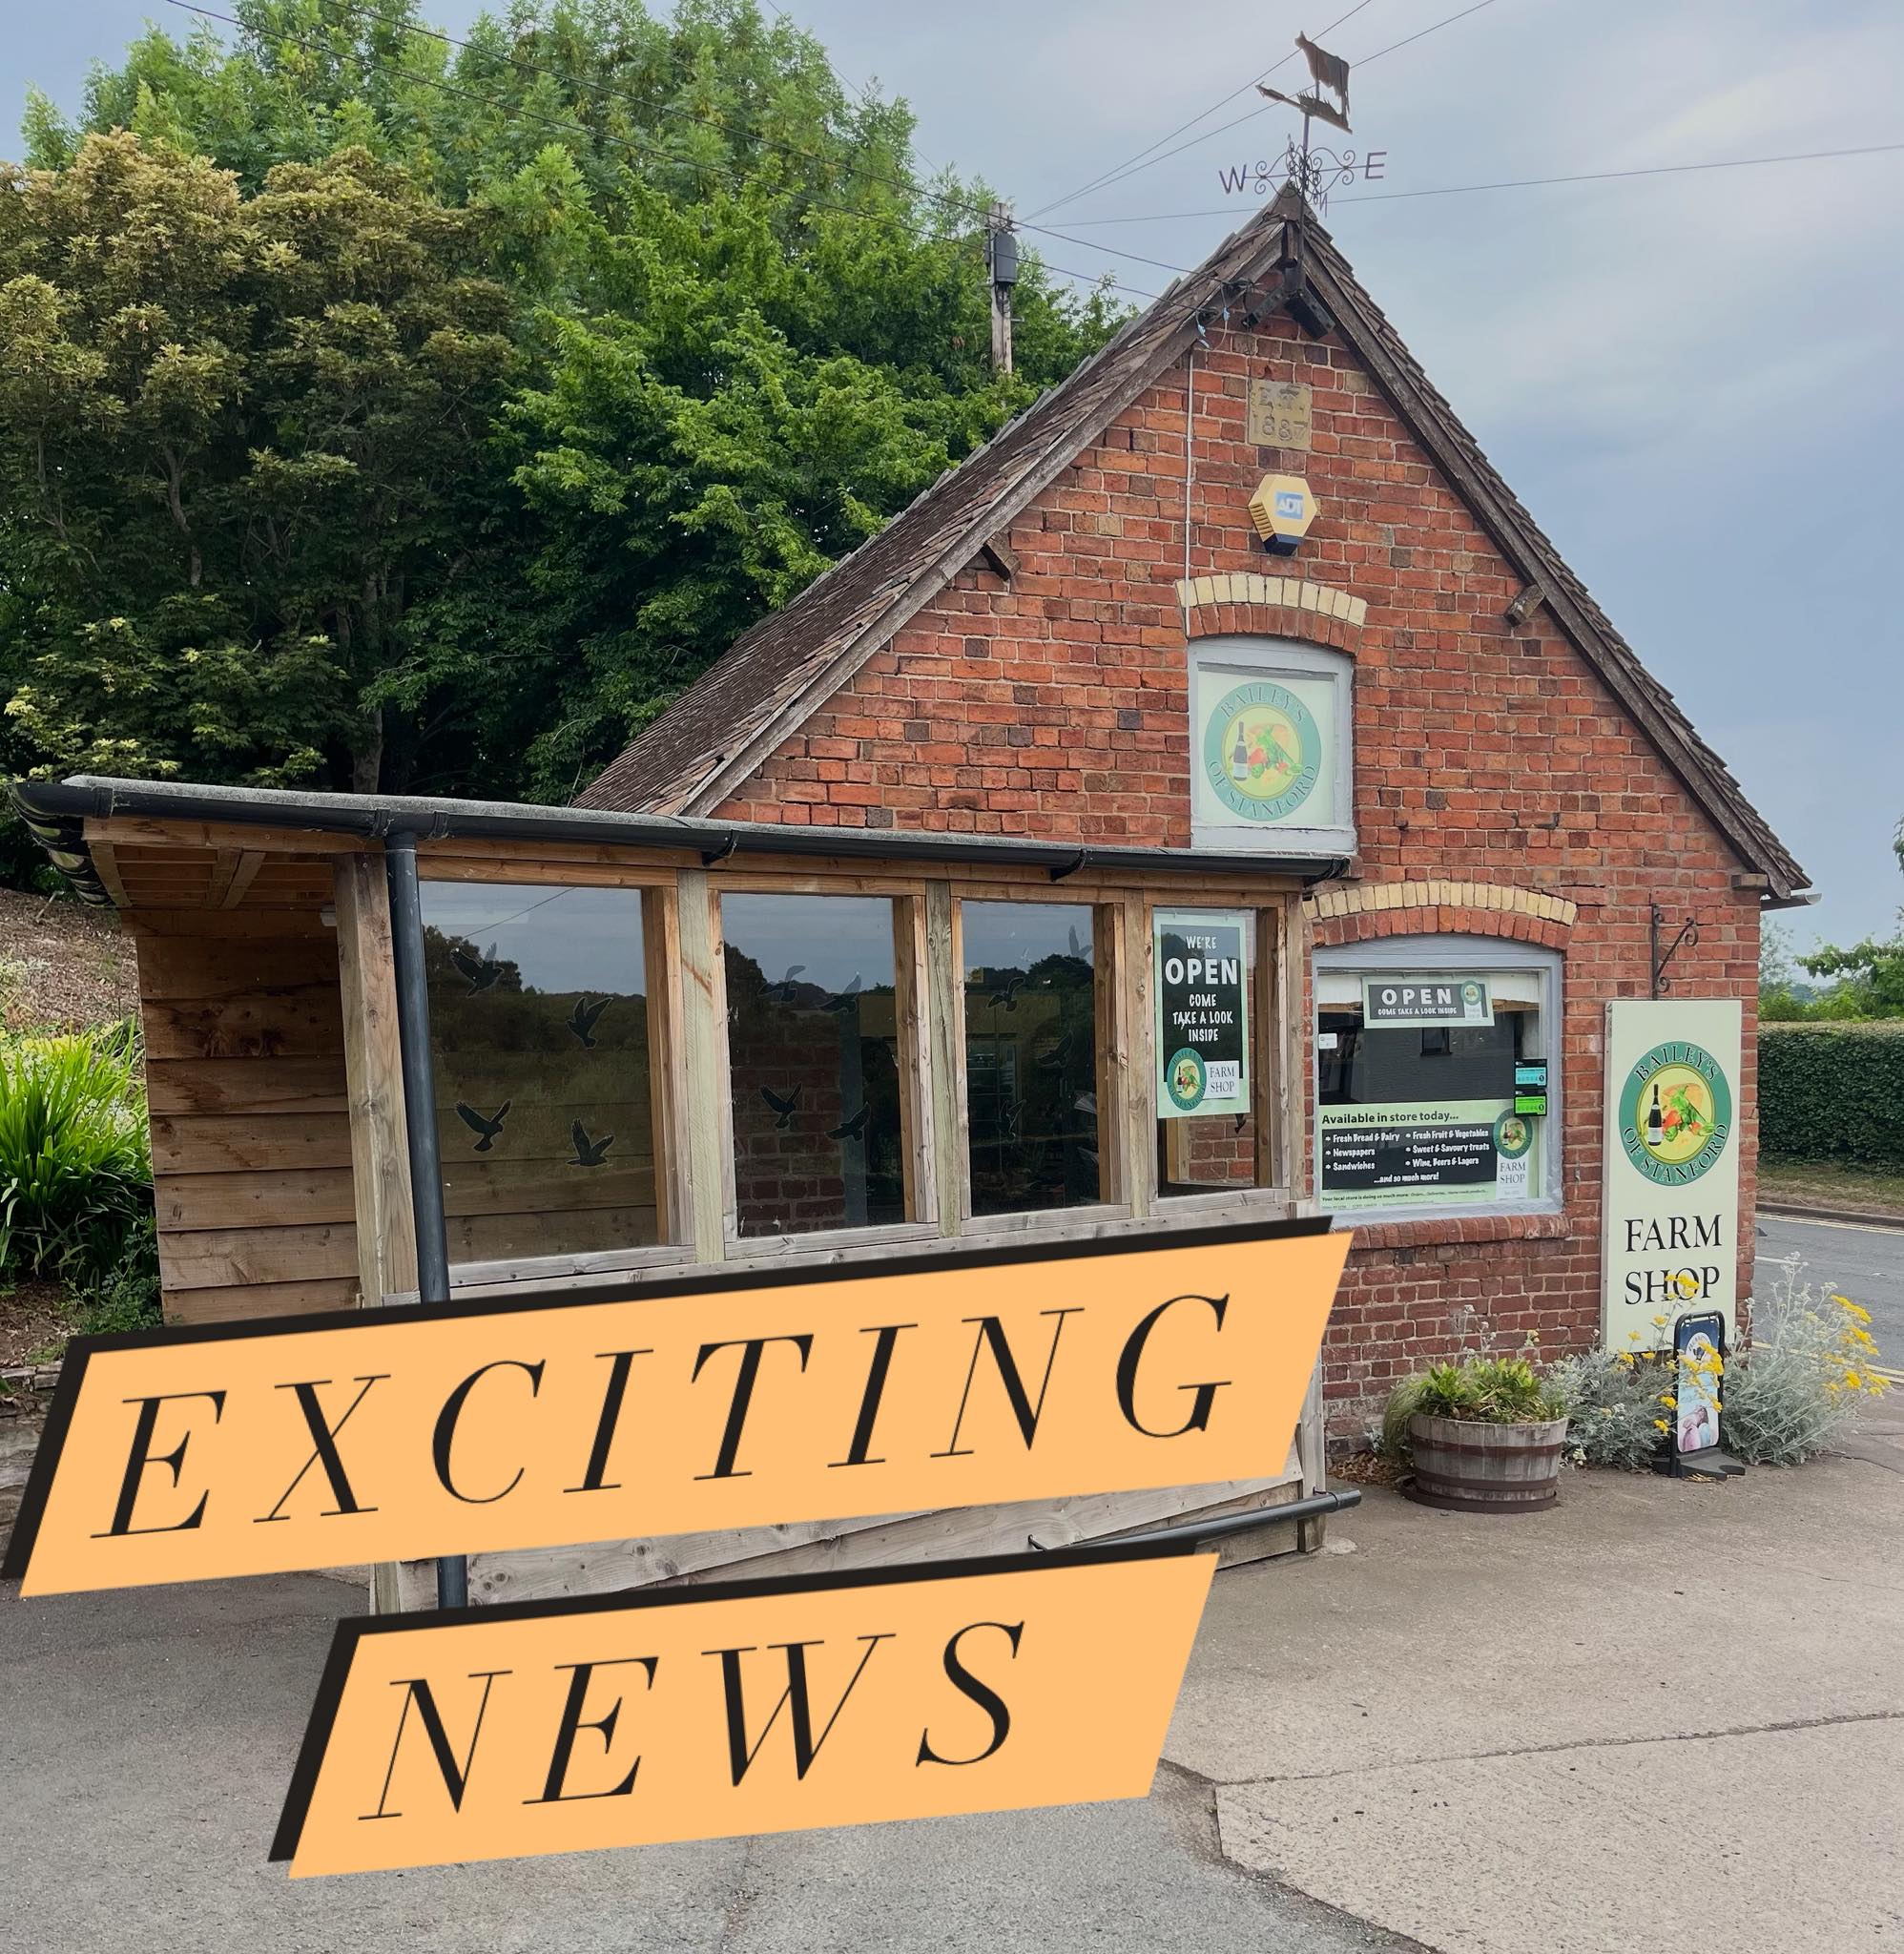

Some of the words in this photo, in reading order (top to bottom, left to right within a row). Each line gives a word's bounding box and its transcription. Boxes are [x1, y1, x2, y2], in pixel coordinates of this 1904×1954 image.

[1365, 152, 1387, 179] E
[1219, 164, 1247, 194] W
[1276, 497, 1303, 515] ADT
[1220, 685, 1306, 723] BAILEY'S
[1209, 759, 1230, 788] OF
[1228, 764, 1316, 819] STANFORD
[1186, 935, 1217, 949] WE'RE
[1165, 957, 1238, 986] OPEN
[1189, 993, 1217, 1008] COME
[1381, 988, 1452, 1006] OPEN
[1172, 1011, 1197, 1028] TAKE
[1199, 1011, 1207, 1025] A
[1210, 1010, 1233, 1025] LOOK
[1188, 1029, 1219, 1042] INSIDE
[1635, 1045, 1721, 1082] BAILEY'S
[1210, 1067, 1235, 1078] FARM
[1210, 1080, 1235, 1093] SHOP
[1322, 1112, 1375, 1124] Available
[1377, 1112, 1388, 1122] in
[1390, 1112, 1418, 1122] store
[1419, 1111, 1459, 1122] today...
[1333, 1133, 1353, 1143] Fresh
[1353, 1133, 1374, 1142] Bread
[1375, 1133, 1380, 1141] &
[1380, 1132, 1400, 1142] Dairy
[1413, 1131, 1431, 1139] Fresh
[1432, 1130, 1448, 1138] Fruit
[1449, 1130, 1455, 1138] &
[1455, 1129, 1489, 1138] Vegetables
[1333, 1148, 1376, 1157] Newspapers
[1413, 1144, 1434, 1154] Sweet
[1435, 1144, 1440, 1153] &
[1440, 1143, 1469, 1153] Savoury
[1624, 1126, 1645, 1156] OF
[1642, 1123, 1728, 1184] STANFORD
[1333, 1160, 1376, 1171] Sandwiches
[1433, 1157, 1451, 1166] Beers
[1451, 1157, 1457, 1166] &
[1457, 1156, 1480, 1166] Lagers
[1500, 1162, 1526, 1173] FARM
[1401, 1173, 1419, 1181] much
[1420, 1172, 1438, 1181] more!
[1500, 1174, 1525, 1184] SHOP
[1624, 1214, 1723, 1253] FARM
[1625, 1266, 1721, 1305] SHOP
